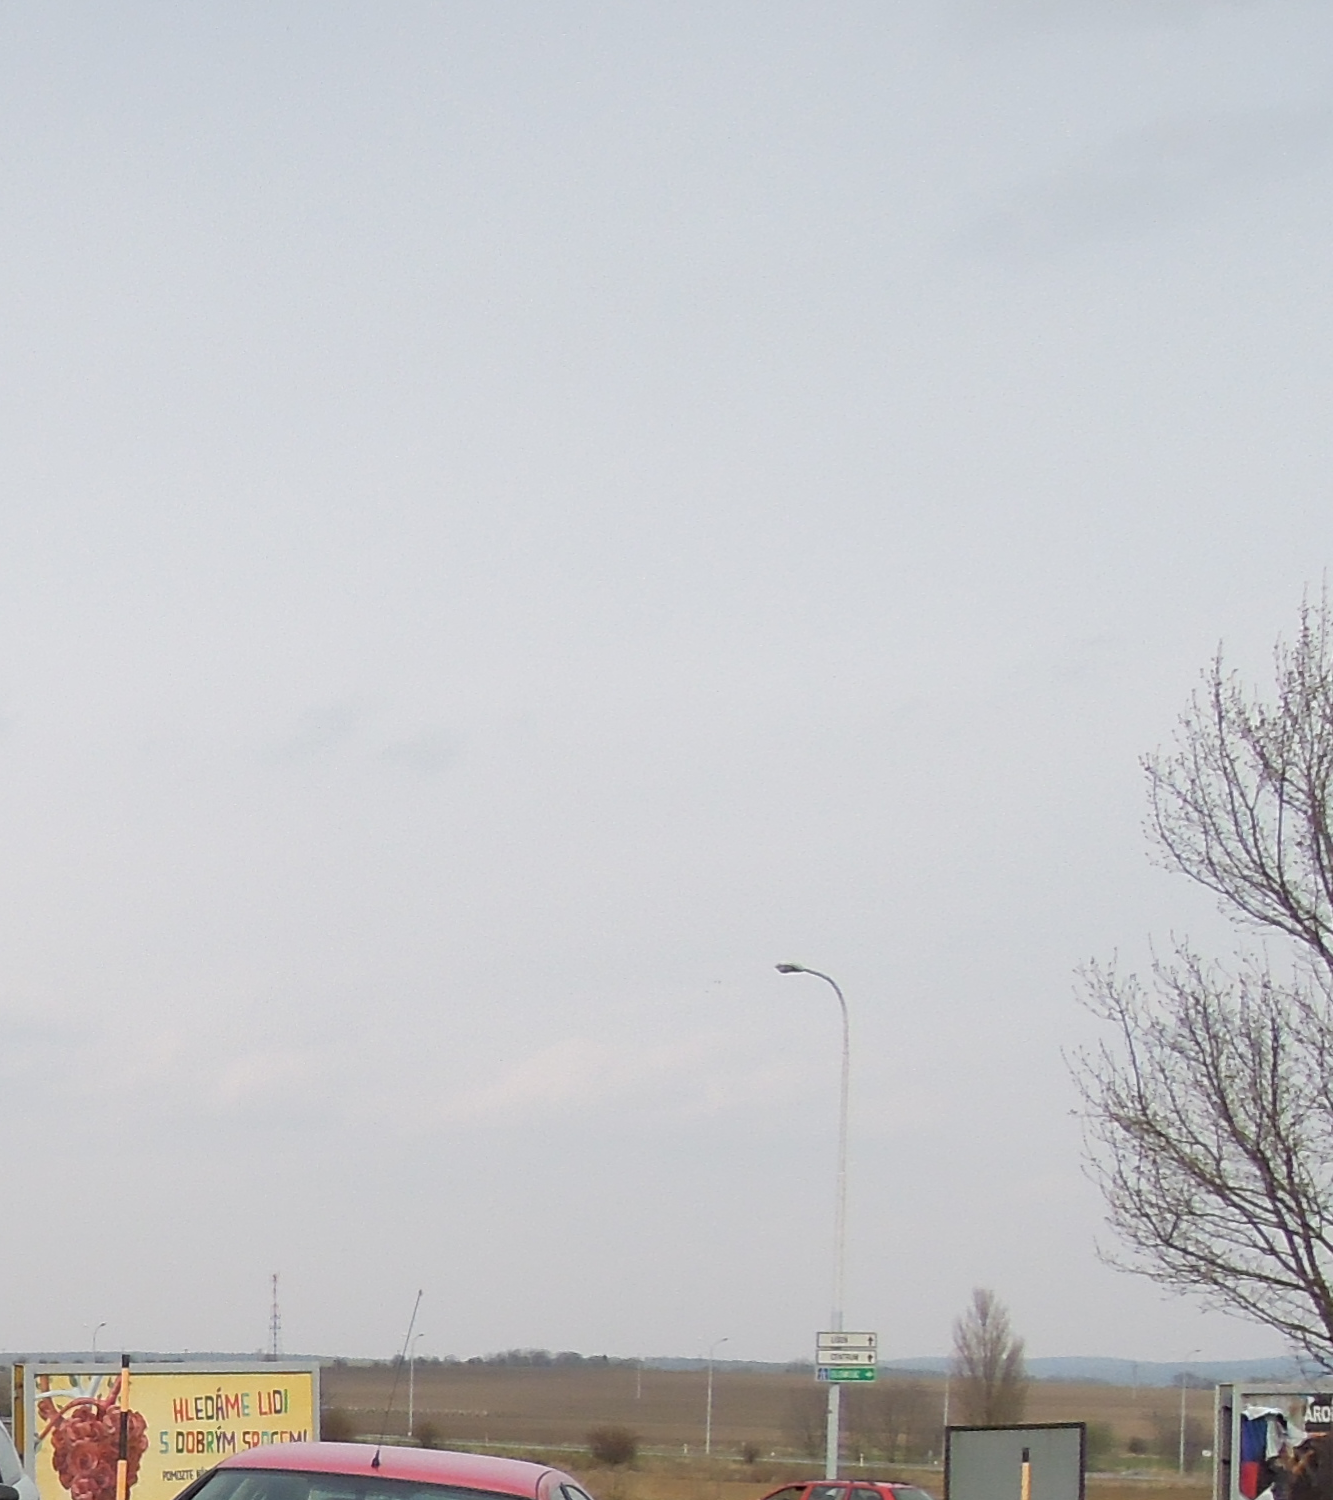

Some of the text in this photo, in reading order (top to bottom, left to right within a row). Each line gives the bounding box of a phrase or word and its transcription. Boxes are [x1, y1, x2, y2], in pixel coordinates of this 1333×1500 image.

[173, 1387, 289, 1423] HLEDÁME LIDI
[159, 1431, 170, 1454] S
[175, 1426, 237, 1454] DOBRÝM
